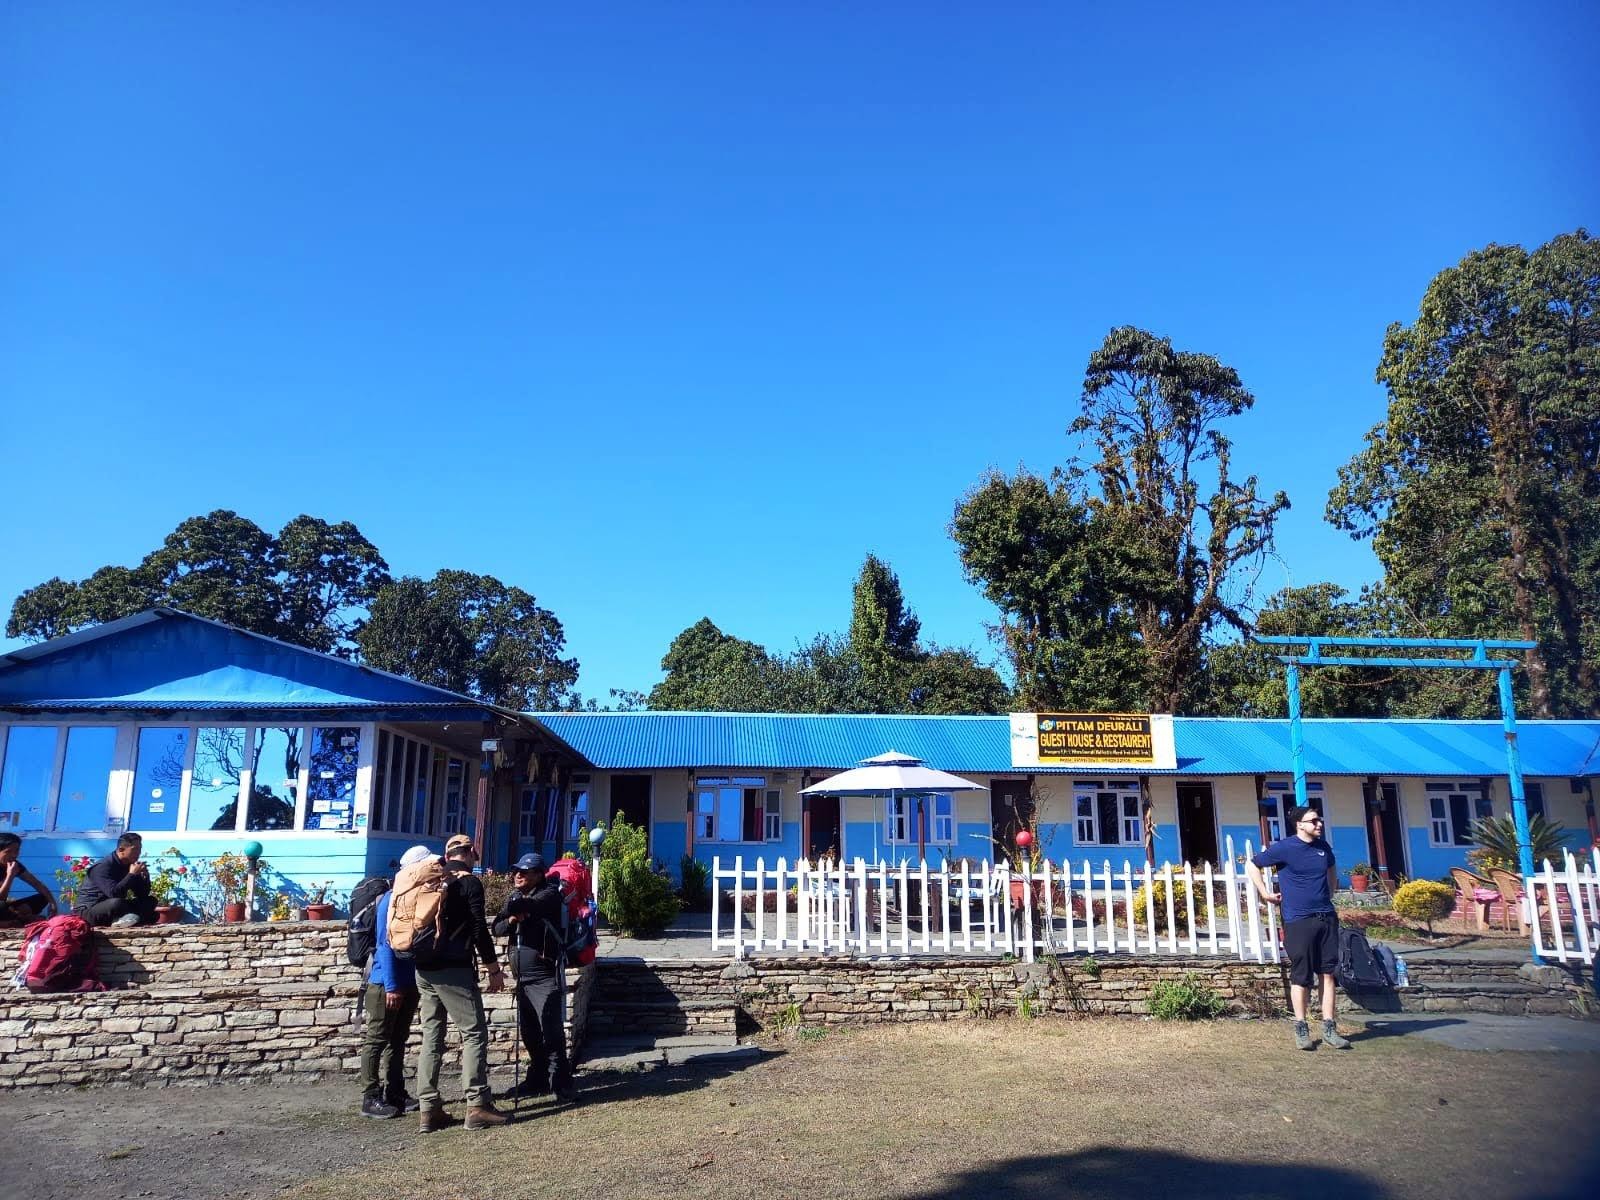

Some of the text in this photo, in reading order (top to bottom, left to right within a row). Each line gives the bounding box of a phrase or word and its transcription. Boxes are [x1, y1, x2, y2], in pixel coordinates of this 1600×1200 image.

[1056, 721, 1094, 731] PITTAM
[1097, 721, 1142, 731] DEURALI
[1040, 734, 1151, 748] GUEST HOUSE & RESTAURENT
